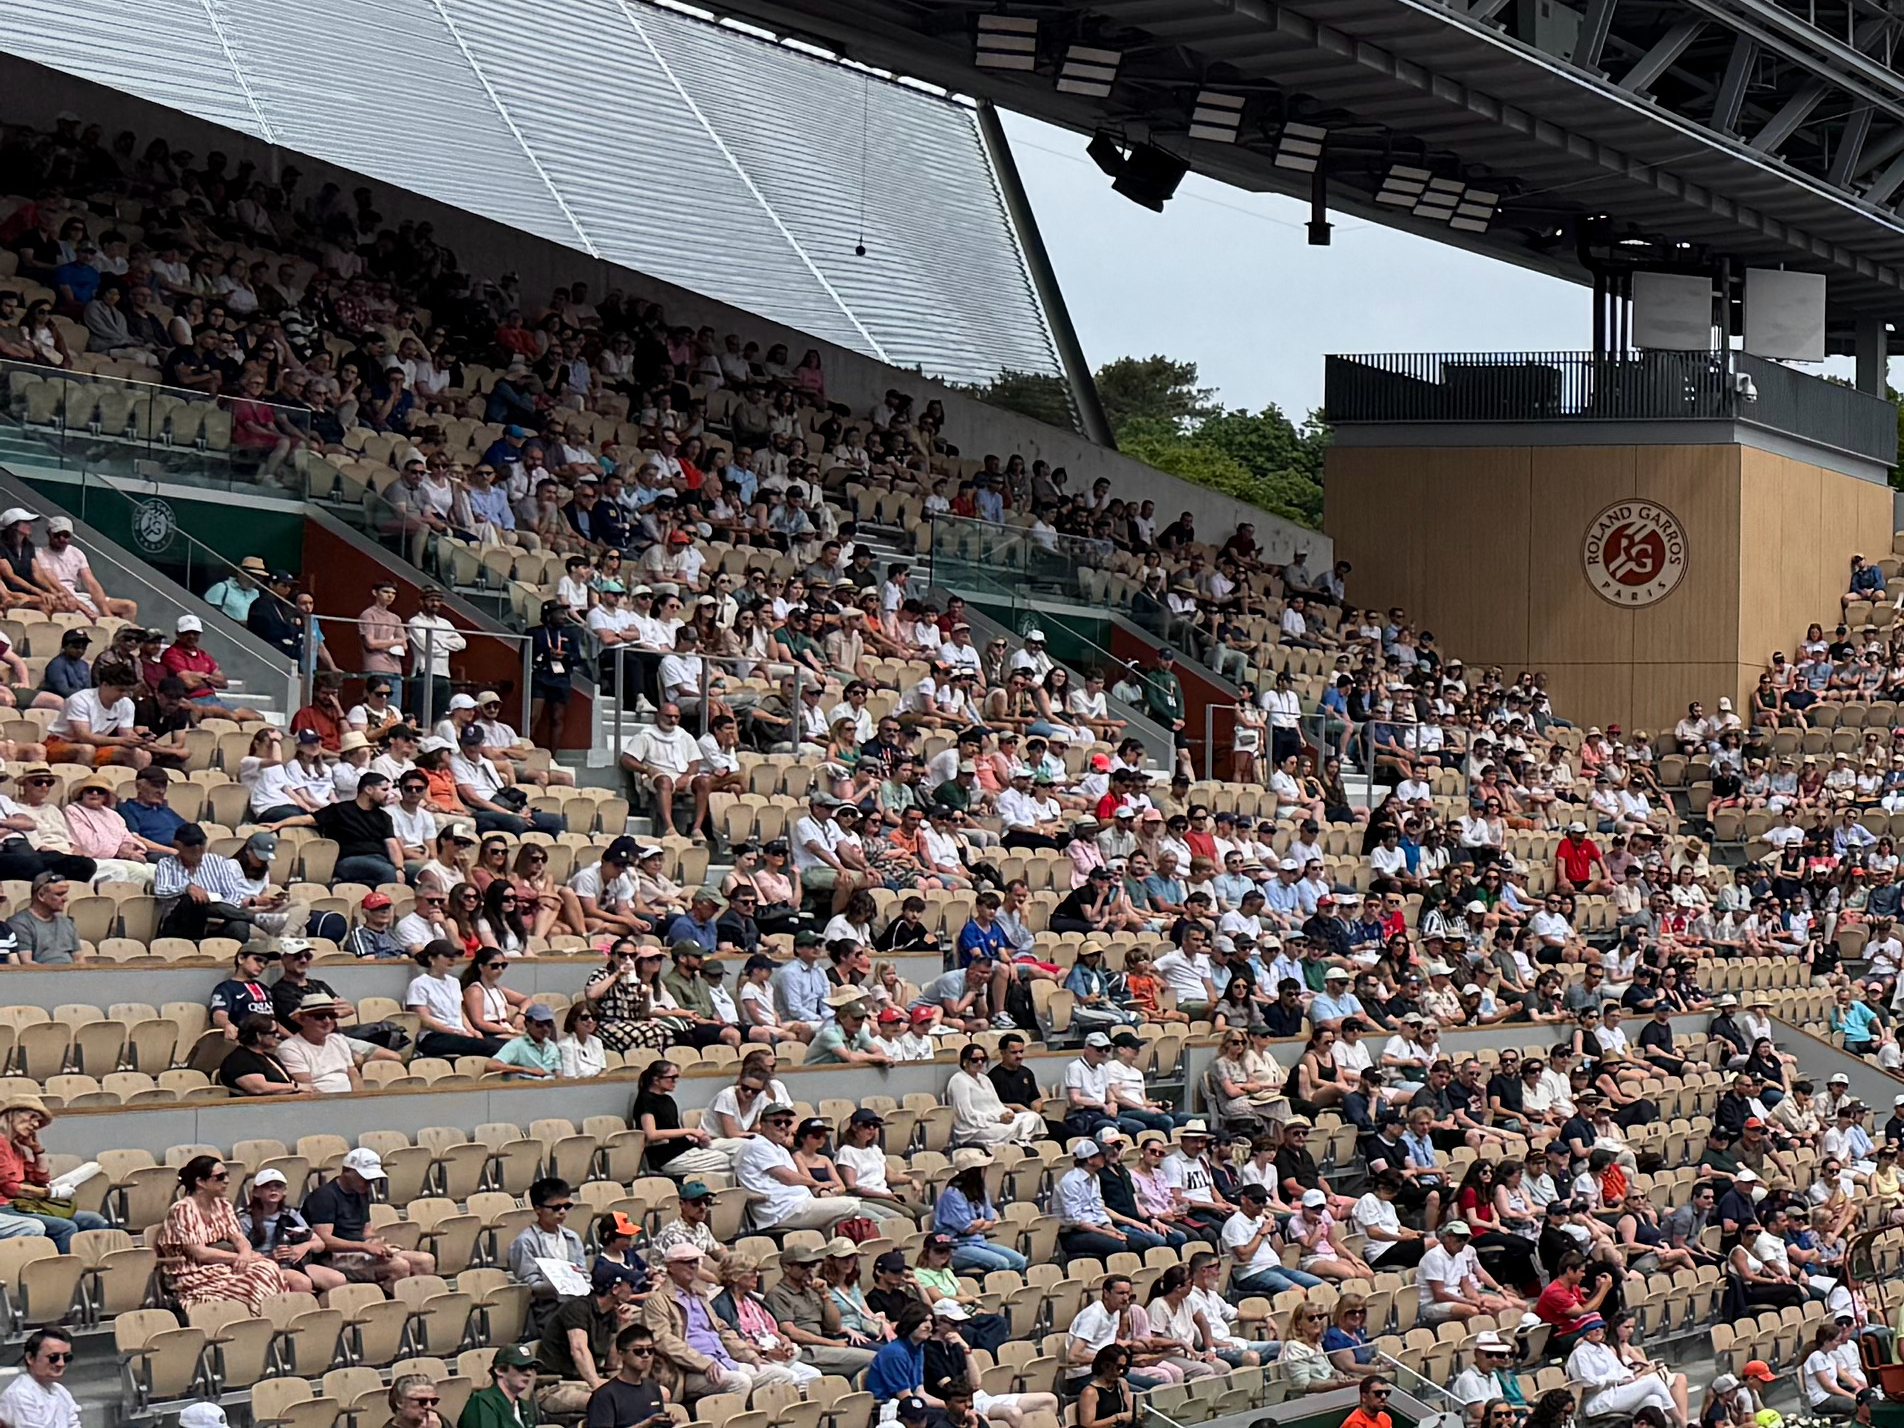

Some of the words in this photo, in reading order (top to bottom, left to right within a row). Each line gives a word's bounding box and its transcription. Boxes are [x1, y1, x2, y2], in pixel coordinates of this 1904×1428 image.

[1586, 506, 1633, 566] ROLAND
[1638, 506, 1683, 566] GARROS
[1601, 580, 1667, 602] PARIS
